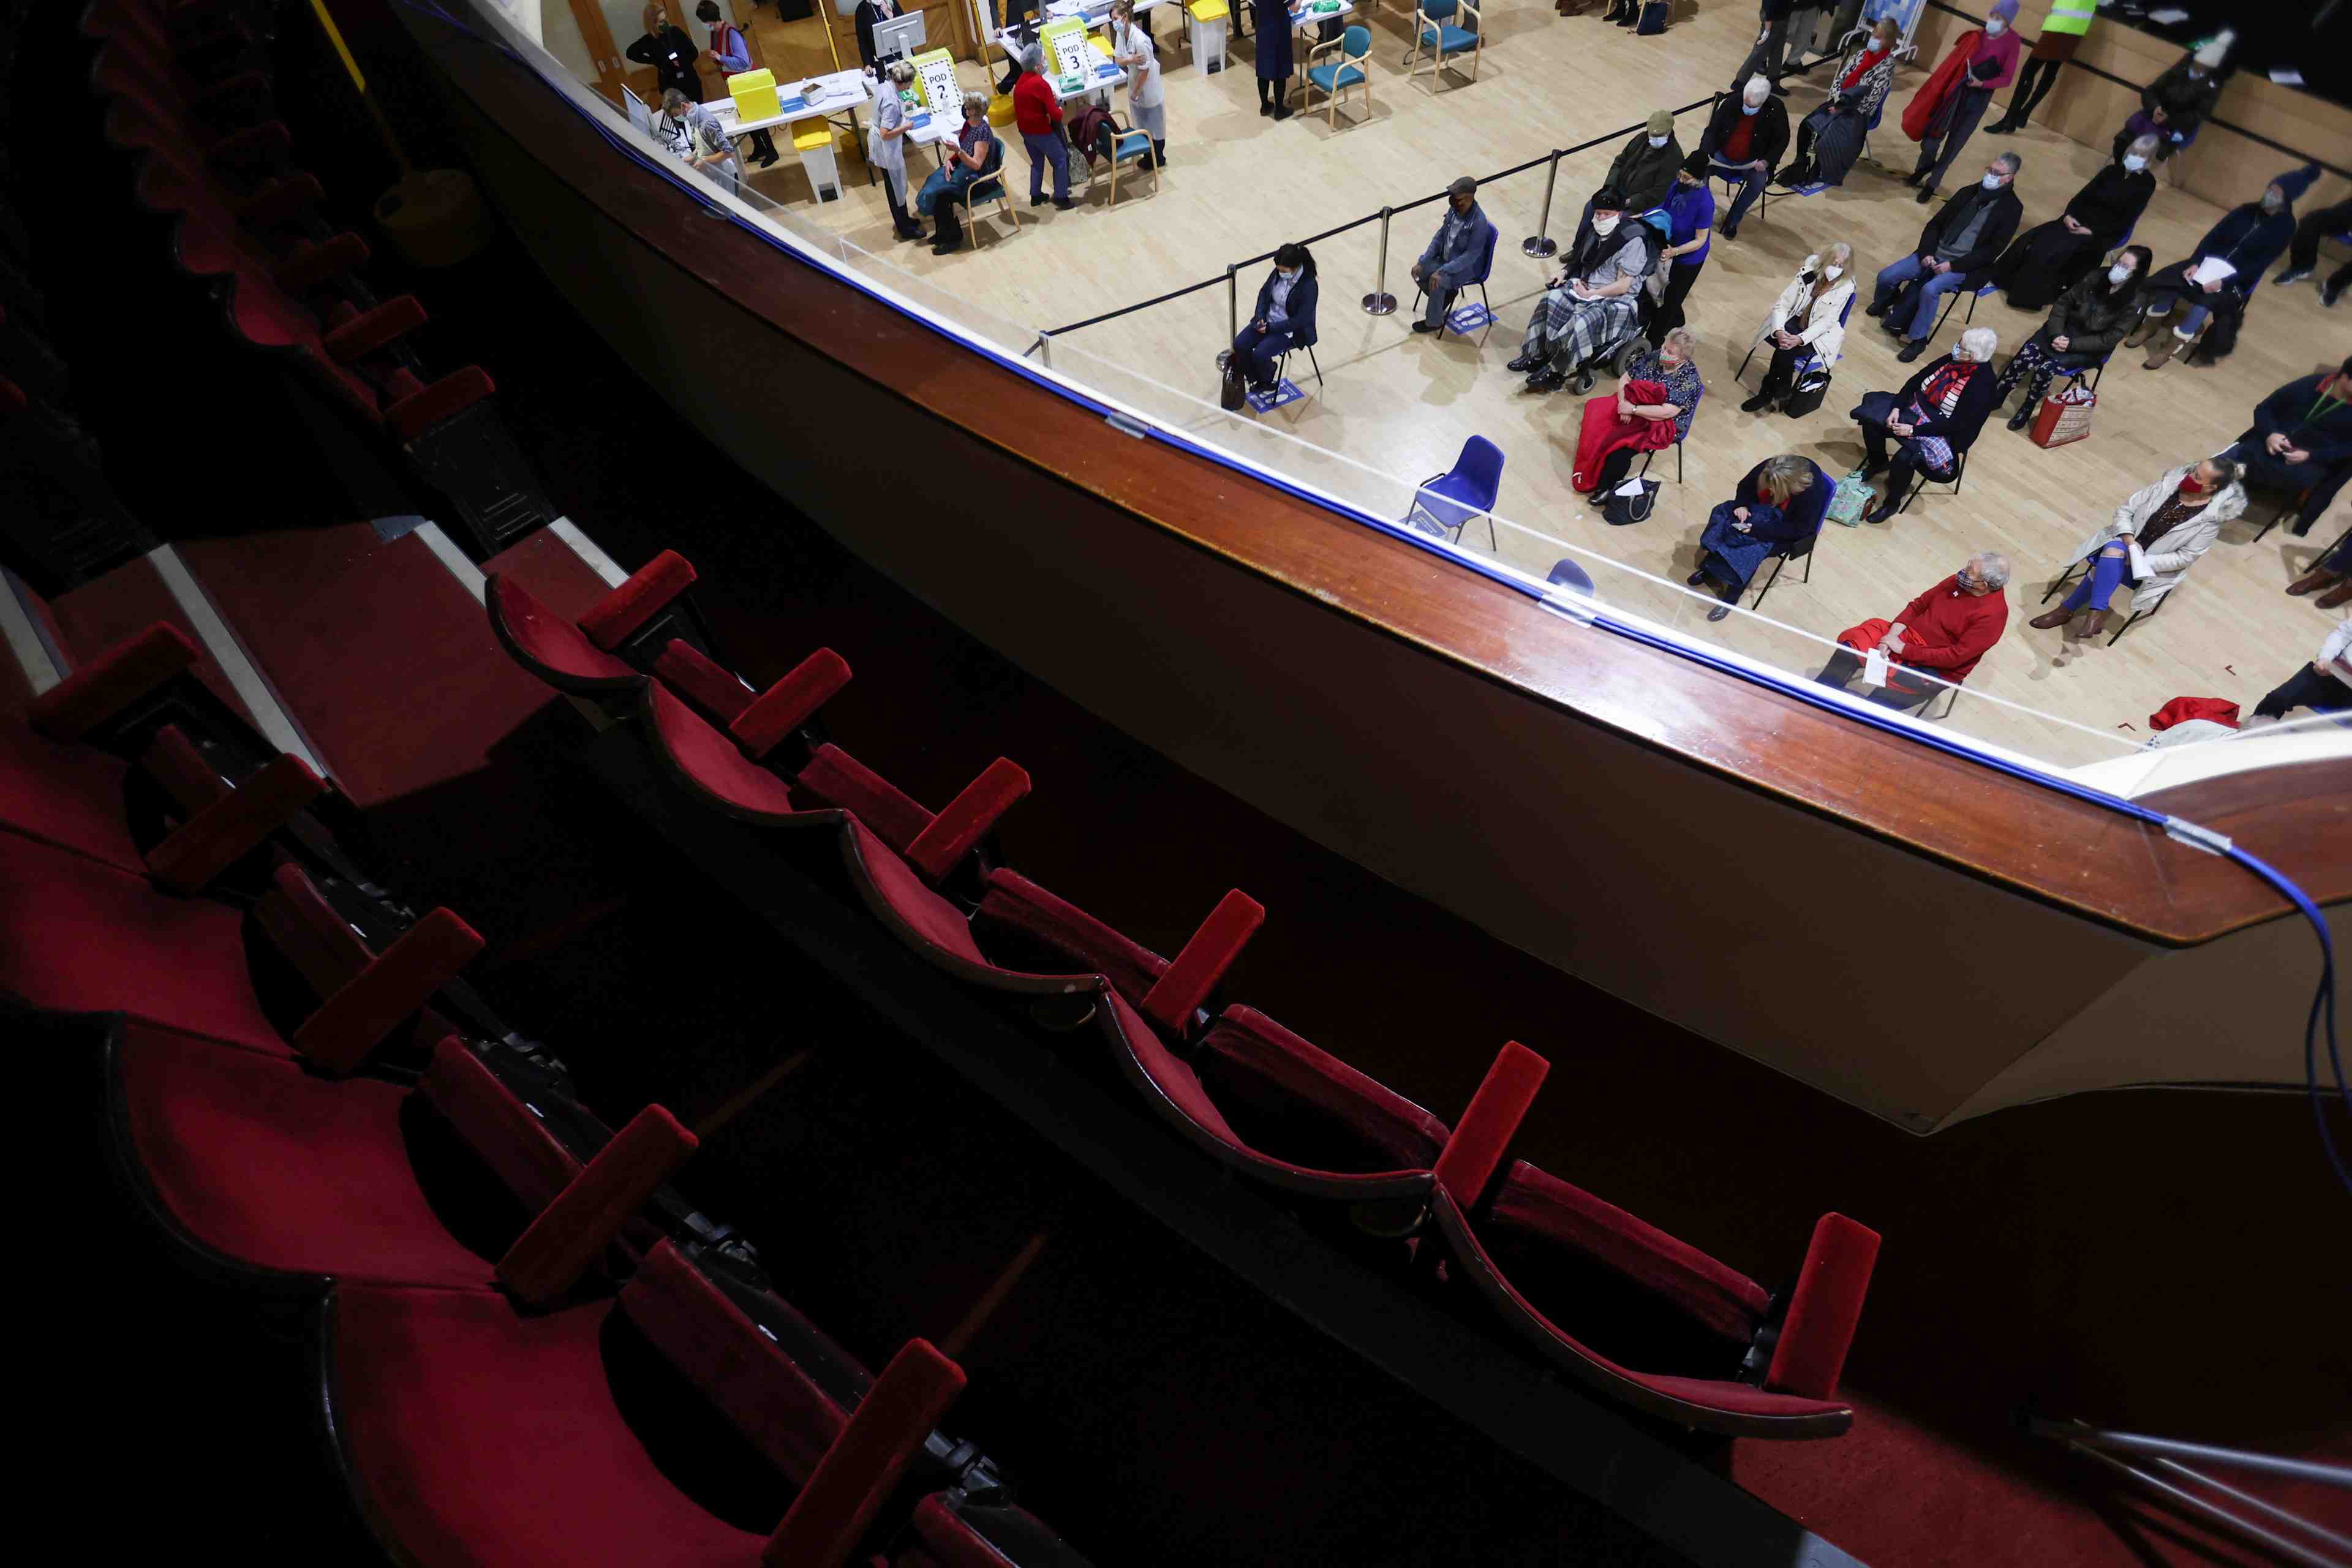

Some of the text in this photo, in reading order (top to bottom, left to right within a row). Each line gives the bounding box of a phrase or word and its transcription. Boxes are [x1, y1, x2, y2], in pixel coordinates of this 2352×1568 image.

[1063, 45, 1079, 55] POD
[1070, 56, 1079, 69] 3
[929, 74, 947, 84] POD
